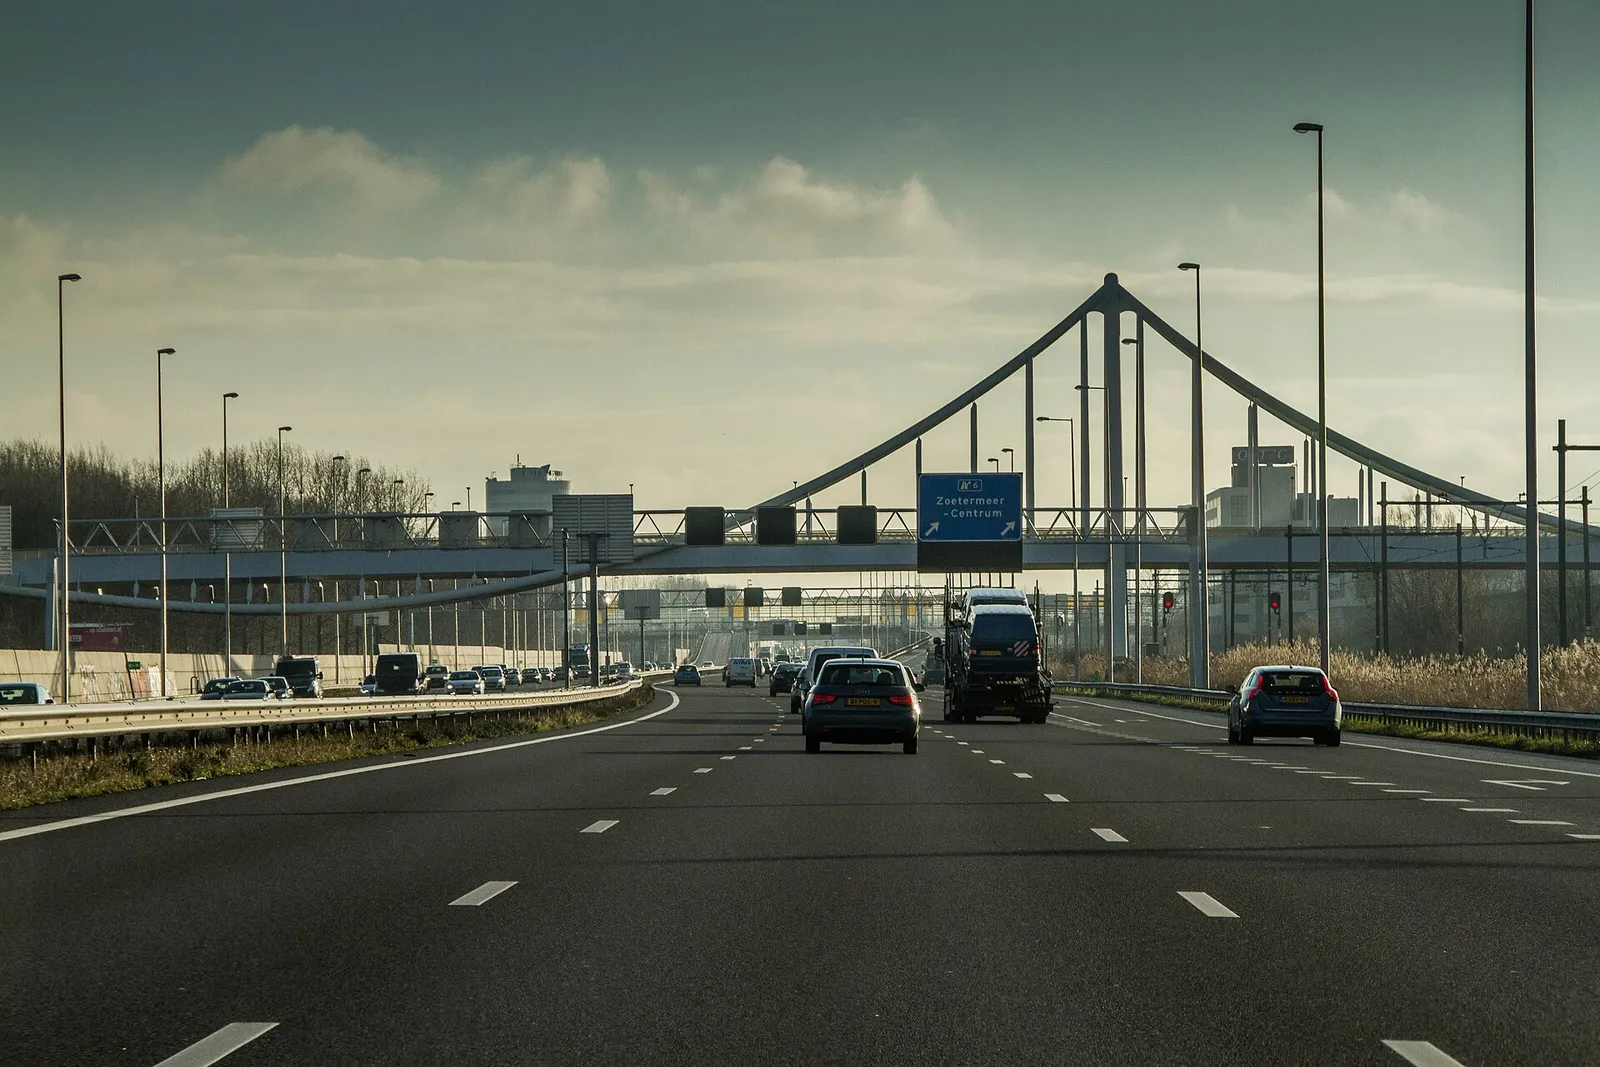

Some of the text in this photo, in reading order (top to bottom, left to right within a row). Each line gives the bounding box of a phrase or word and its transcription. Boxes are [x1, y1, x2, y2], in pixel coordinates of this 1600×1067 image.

[972, 481, 979, 489] 6
[936, 496, 1005, 505] Zoetermeer
[943, 509, 1002, 518] -Centrum
